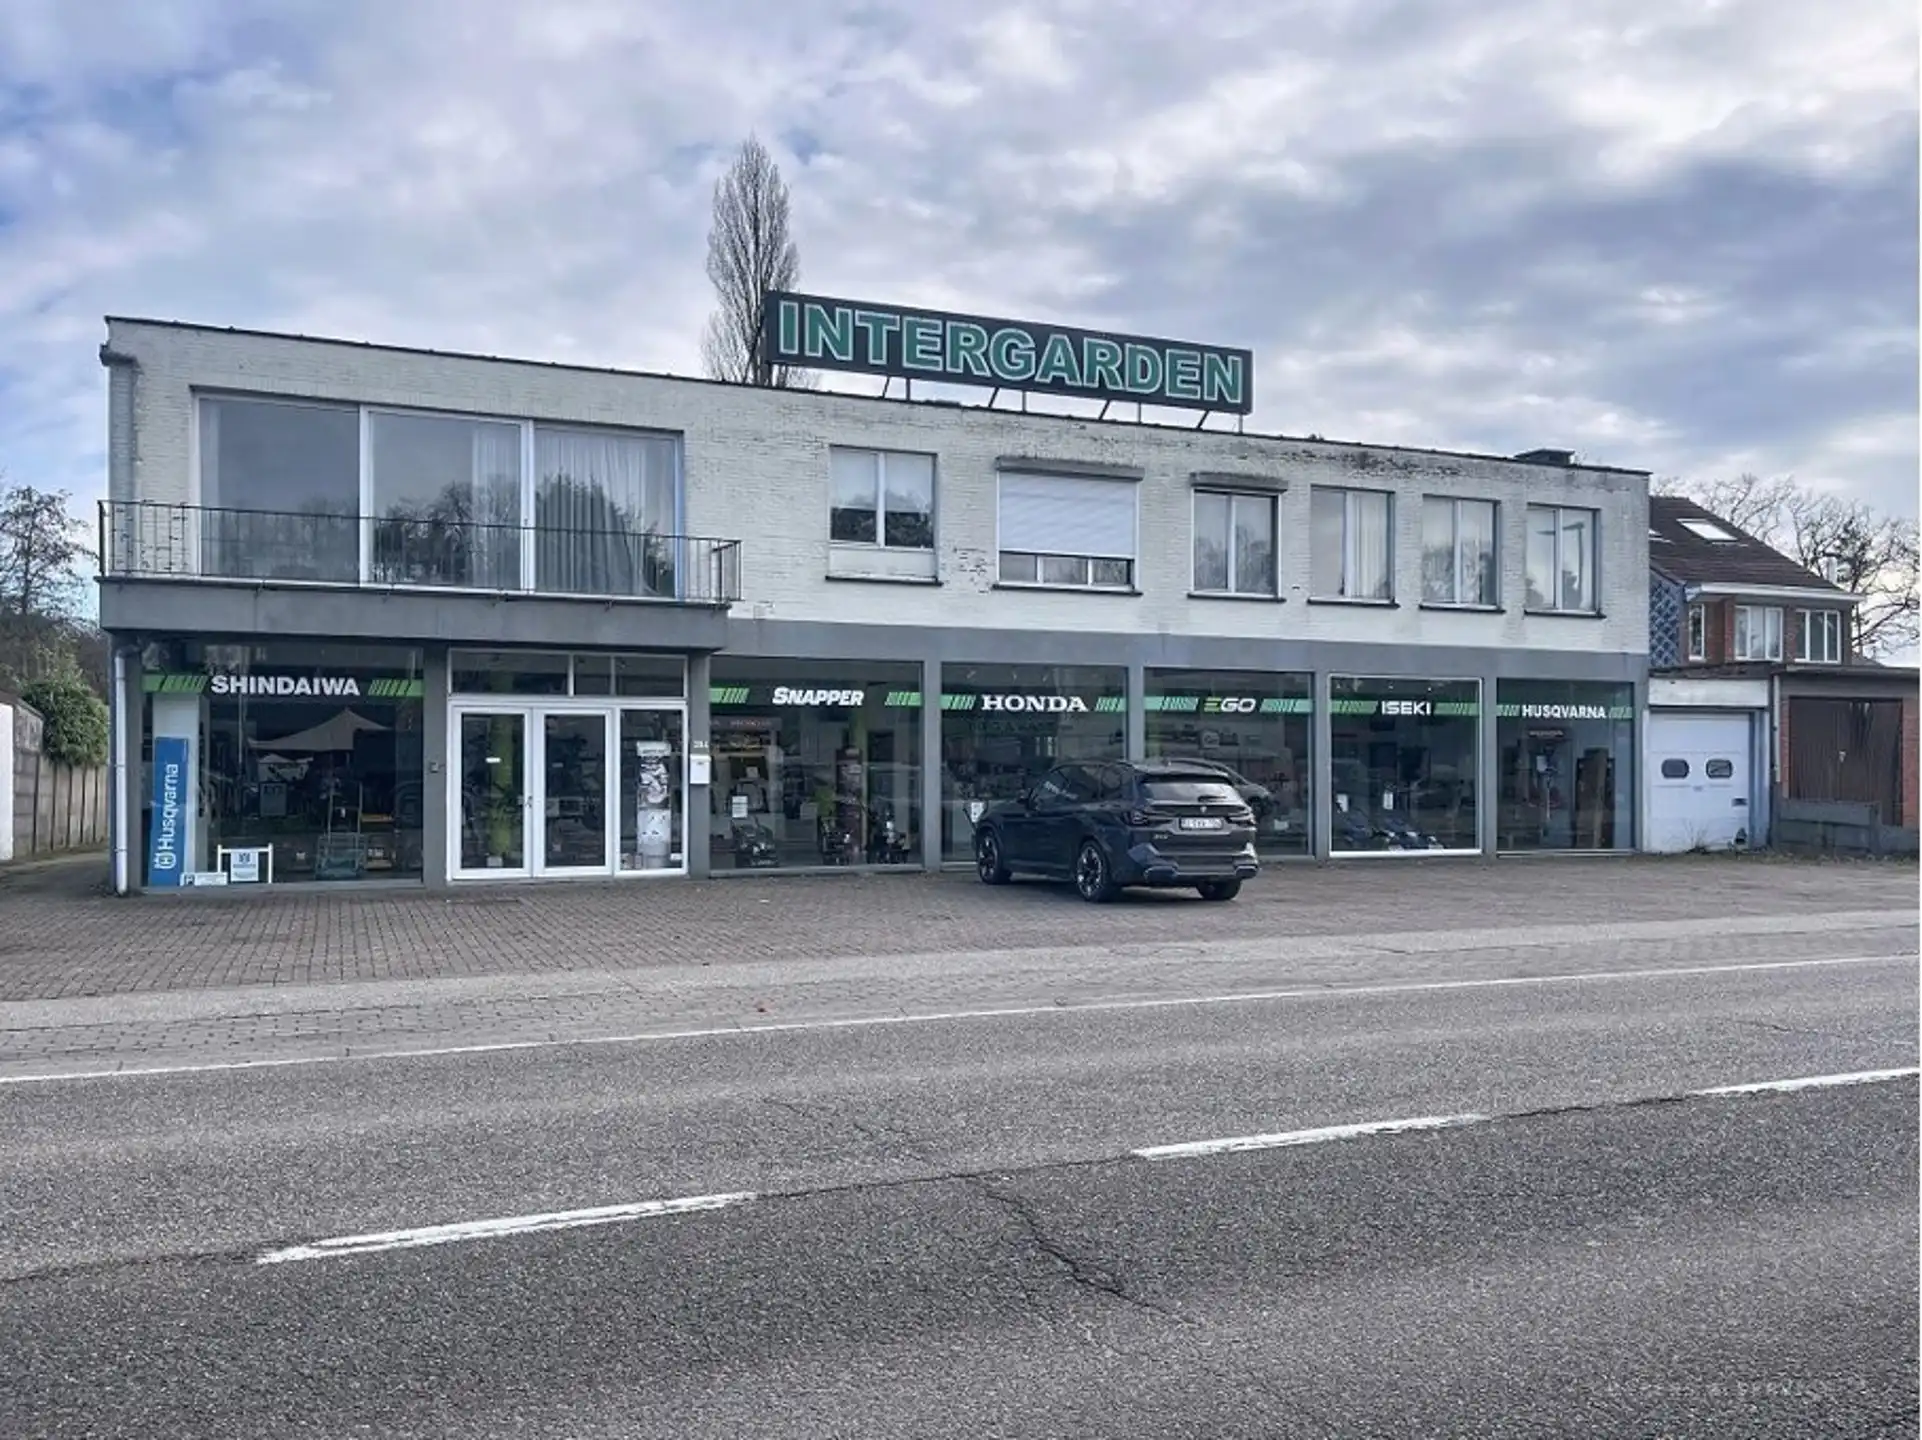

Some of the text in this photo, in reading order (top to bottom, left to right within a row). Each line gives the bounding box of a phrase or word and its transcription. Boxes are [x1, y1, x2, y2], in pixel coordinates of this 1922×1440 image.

[779, 301, 1244, 404] INTERGARDEN
[211, 675, 360, 696] SHINDAIWA
[772, 687, 865, 706] SNAPPER
[981, 695, 1089, 713] HONDA
[1203, 697, 1257, 713] EGO
[1380, 701, 1432, 716] ISEKI
[1521, 704, 1606, 719] HUSQVARNA
[158, 764, 179, 851] Husqvarna
